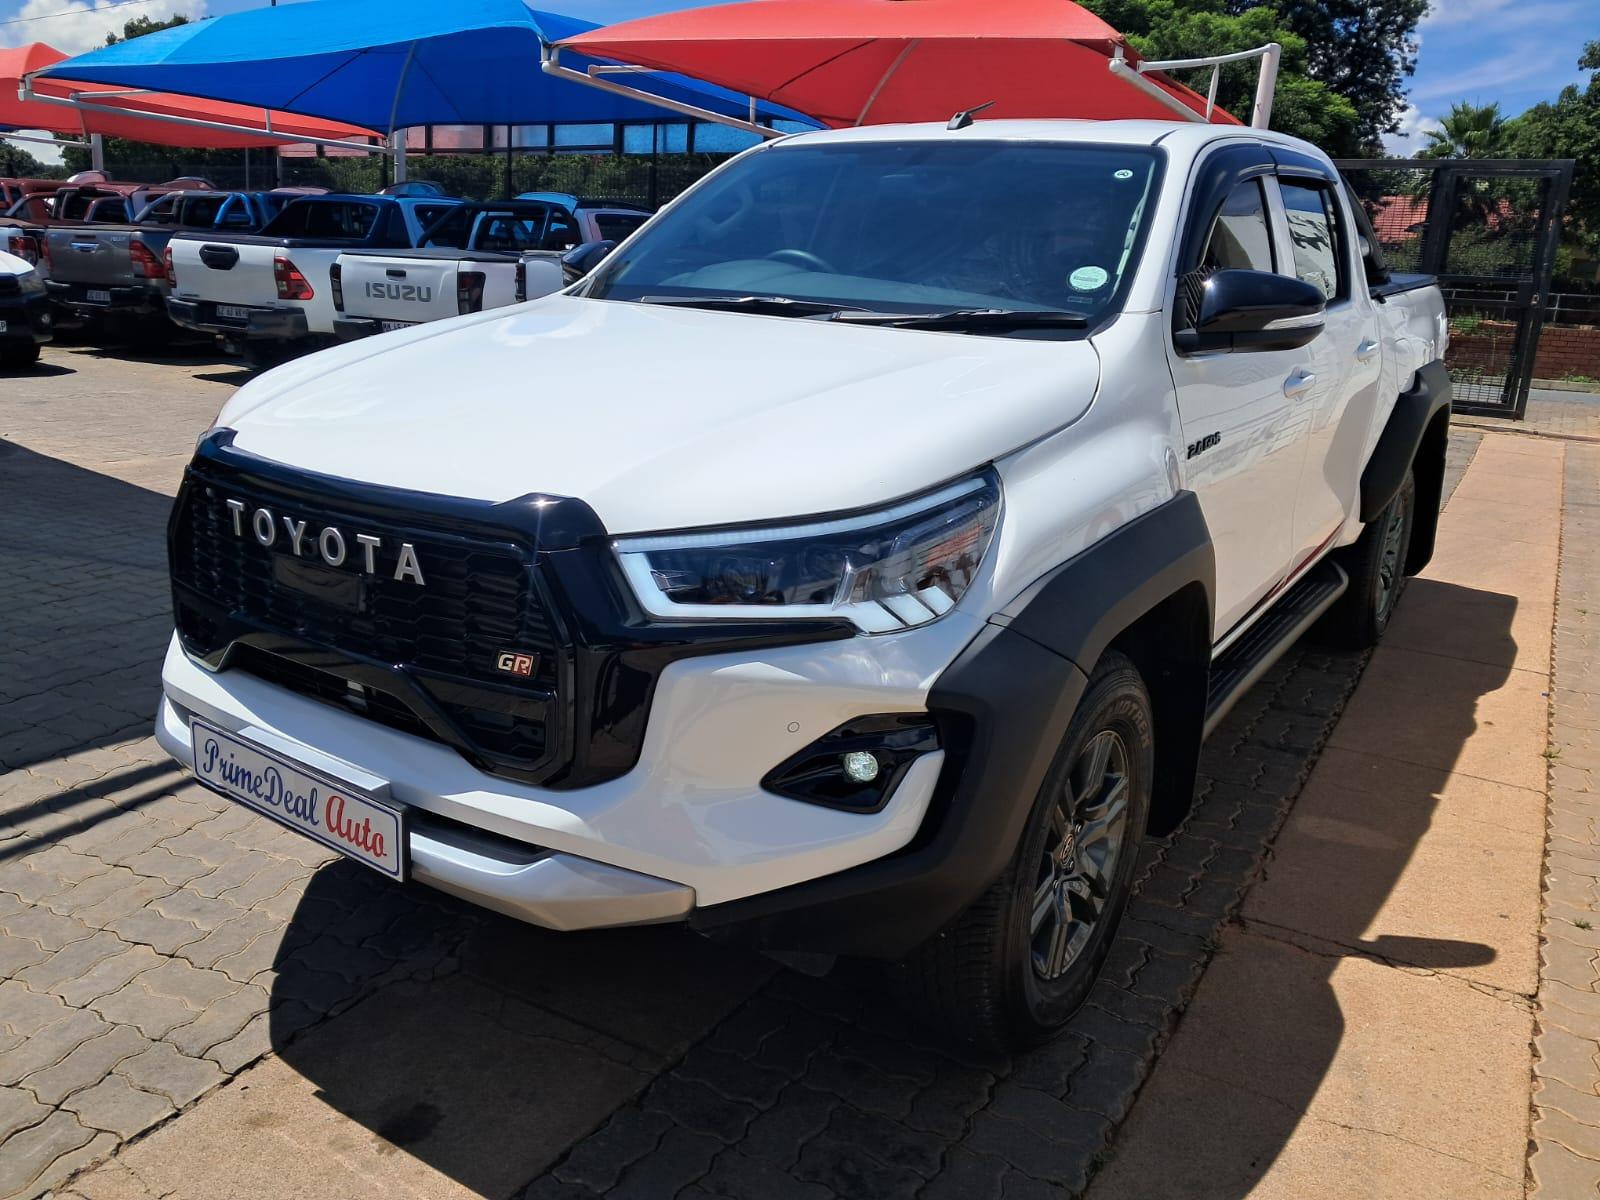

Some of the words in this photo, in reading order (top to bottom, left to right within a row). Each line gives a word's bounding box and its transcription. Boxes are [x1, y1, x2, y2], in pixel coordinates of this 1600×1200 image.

[365, 282, 432, 302] ISUZU
[226, 499, 425, 585] TOYOTA
[498, 654, 531, 674] GR
[203, 739, 319, 825] PrimeDeal
[325, 796, 387, 857] Auto
